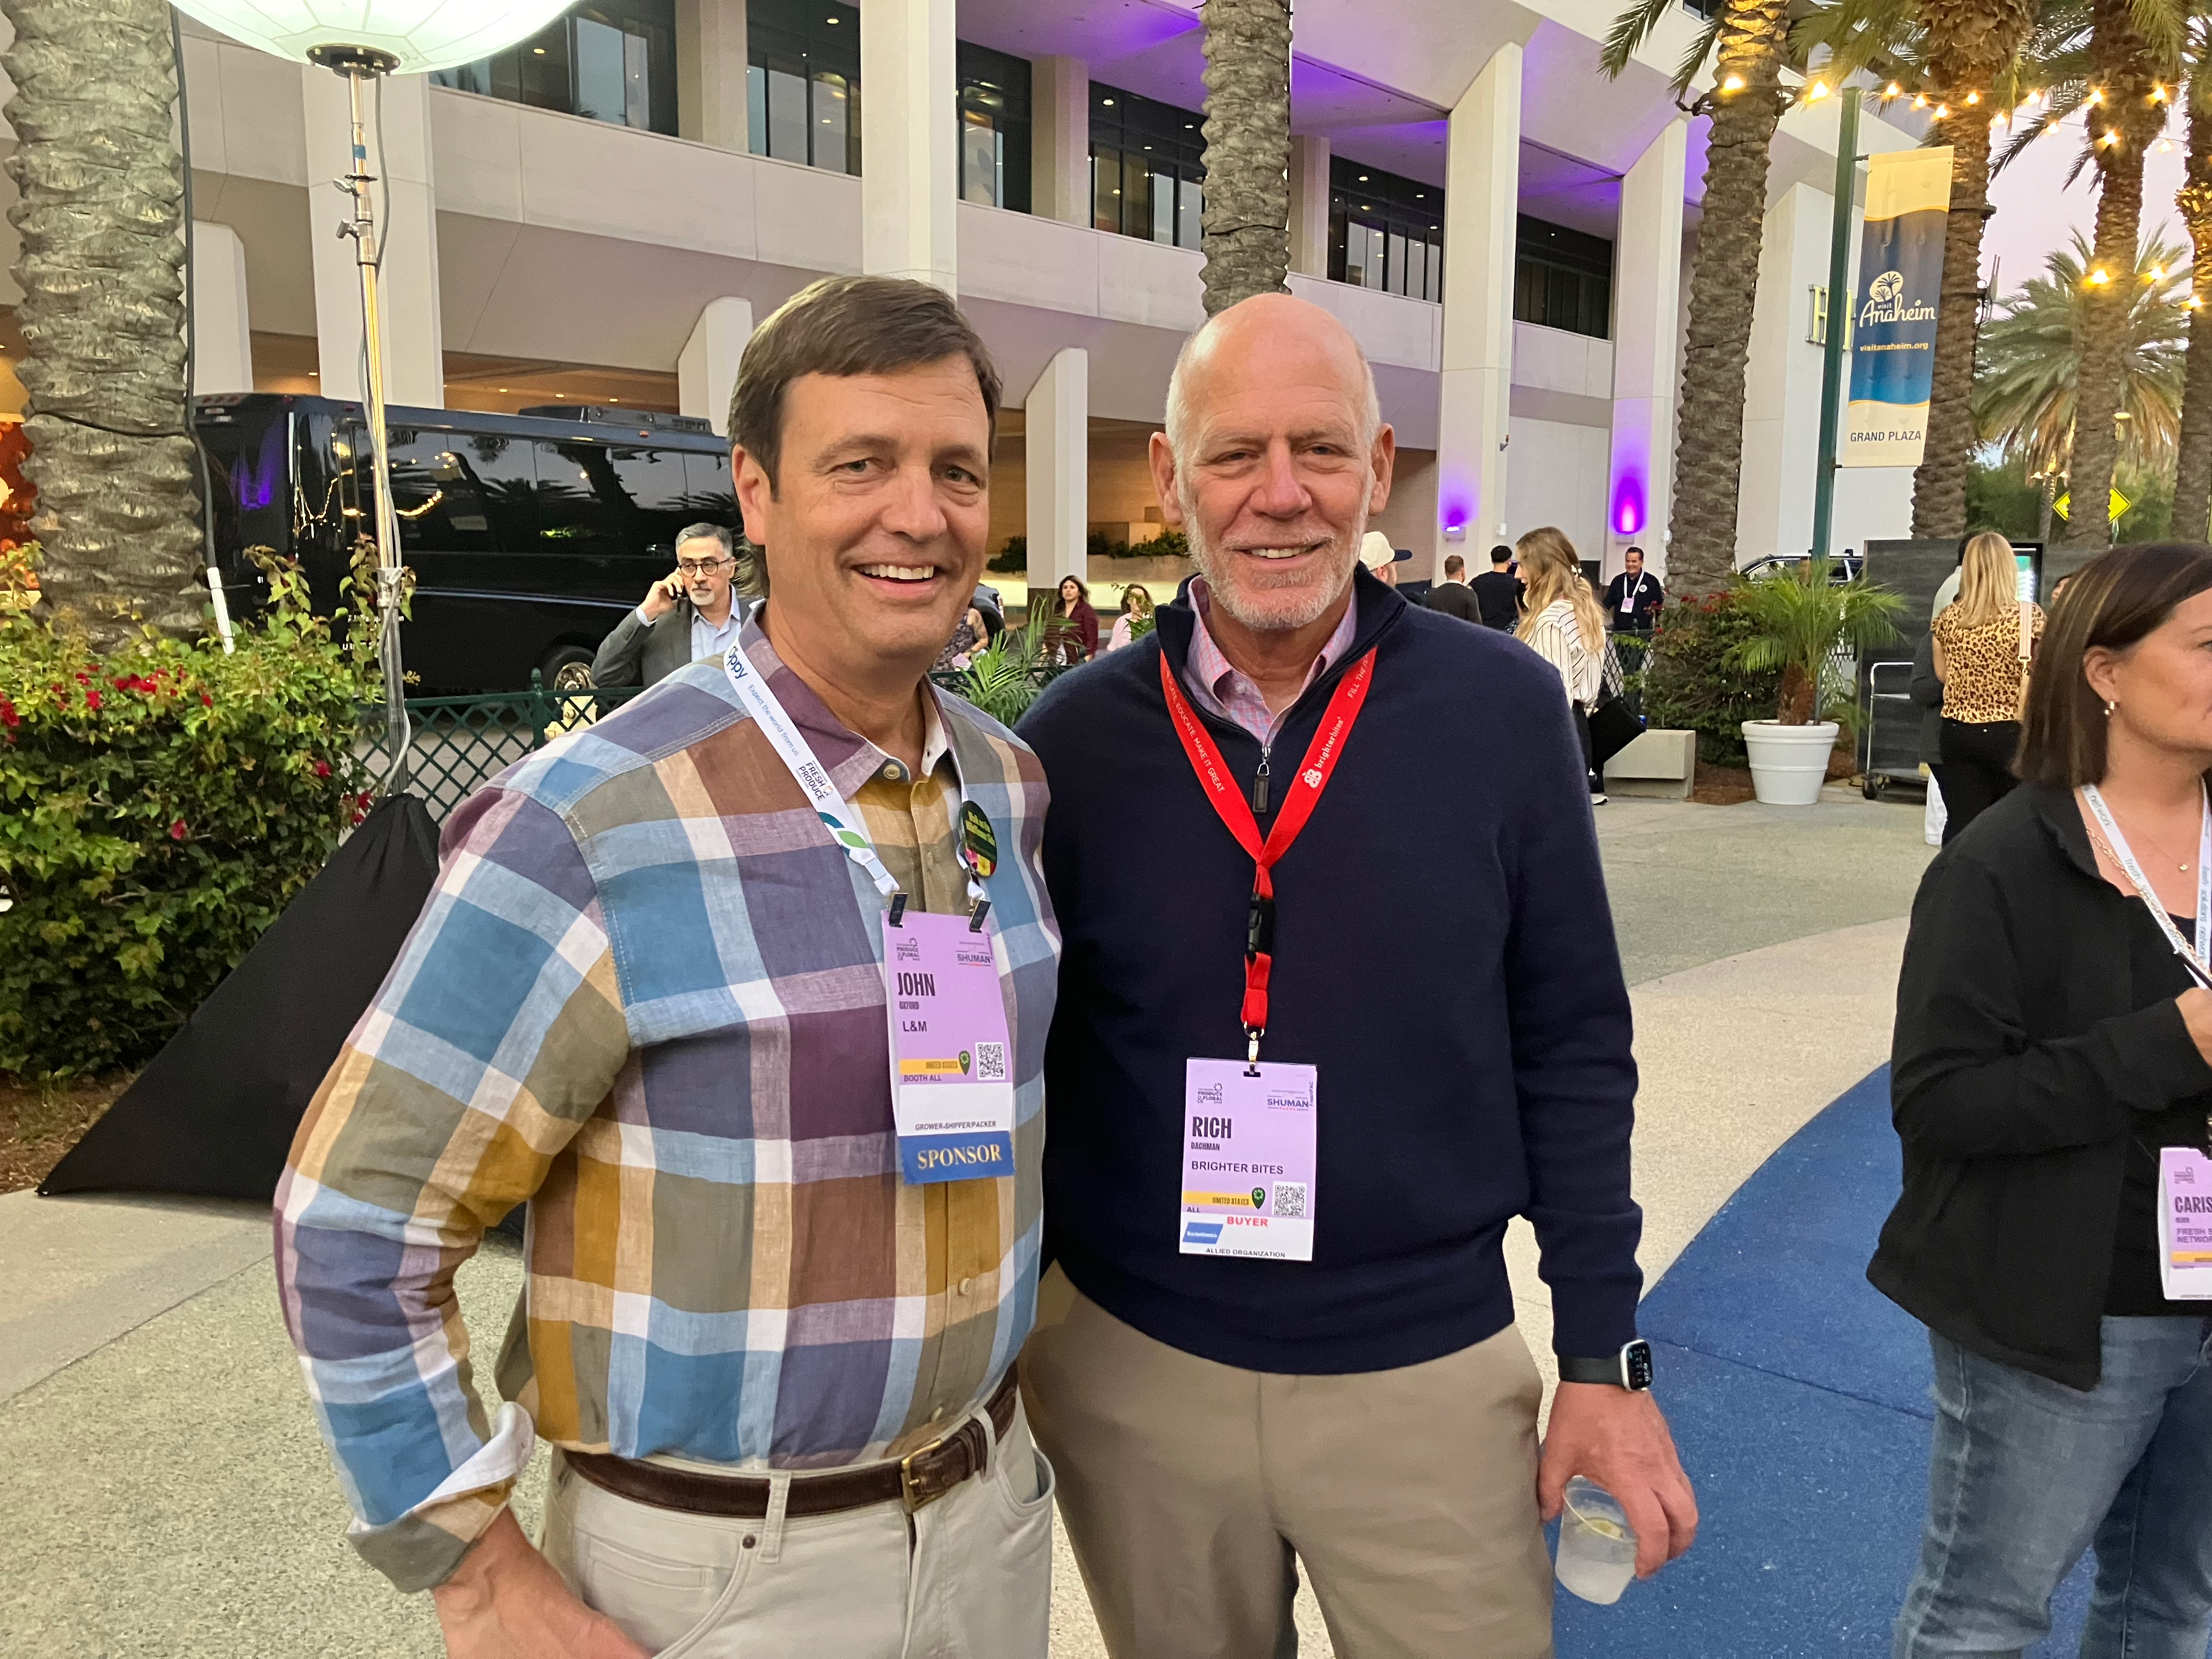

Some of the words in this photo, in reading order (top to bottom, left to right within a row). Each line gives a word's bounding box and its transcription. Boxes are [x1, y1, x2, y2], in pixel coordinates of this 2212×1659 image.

[1859, 293, 1936, 328] Anaheim
[1860, 342, 1928, 352] visitanaheim.org
[1850, 431, 1885, 442] GRAND
[1888, 431, 1921, 441] PLAZA
[1347, 684, 1360, 699] FILL
[1355, 665, 1366, 682] THE
[748, 684, 765, 706] Expect
[761, 704, 771, 716] the
[769, 714, 785, 733] world
[781, 732, 794, 748] from
[1193, 737, 1208, 760] MAKE
[1203, 758, 1212, 767] IT
[798, 766, 826, 802] PRODUCE
[805, 762, 826, 787] FRESH
[1207, 767, 1225, 792] GREAT
[2090, 794, 2113, 827] network
[2125, 858, 2141, 881] fresh
[957, 953, 991, 963] SHUMAN
[897, 972, 935, 996] JOHN
[902, 1020, 928, 1032] L&M
[1267, 1098, 1309, 1108] SHUMAN
[1192, 1116, 1232, 1139] RICH
[917, 1143, 1002, 1170] SPONSOR
[1192, 1160, 1248, 1173] BRIGHTER
[1251, 1164, 1284, 1175] BITES
[1212, 1197, 1231, 1205] UNITED
[1231, 1197, 1249, 1206] STATES
[1227, 1216, 1269, 1227] BUYER
[1232, 1249, 1285, 1258] ORGANIZATION
